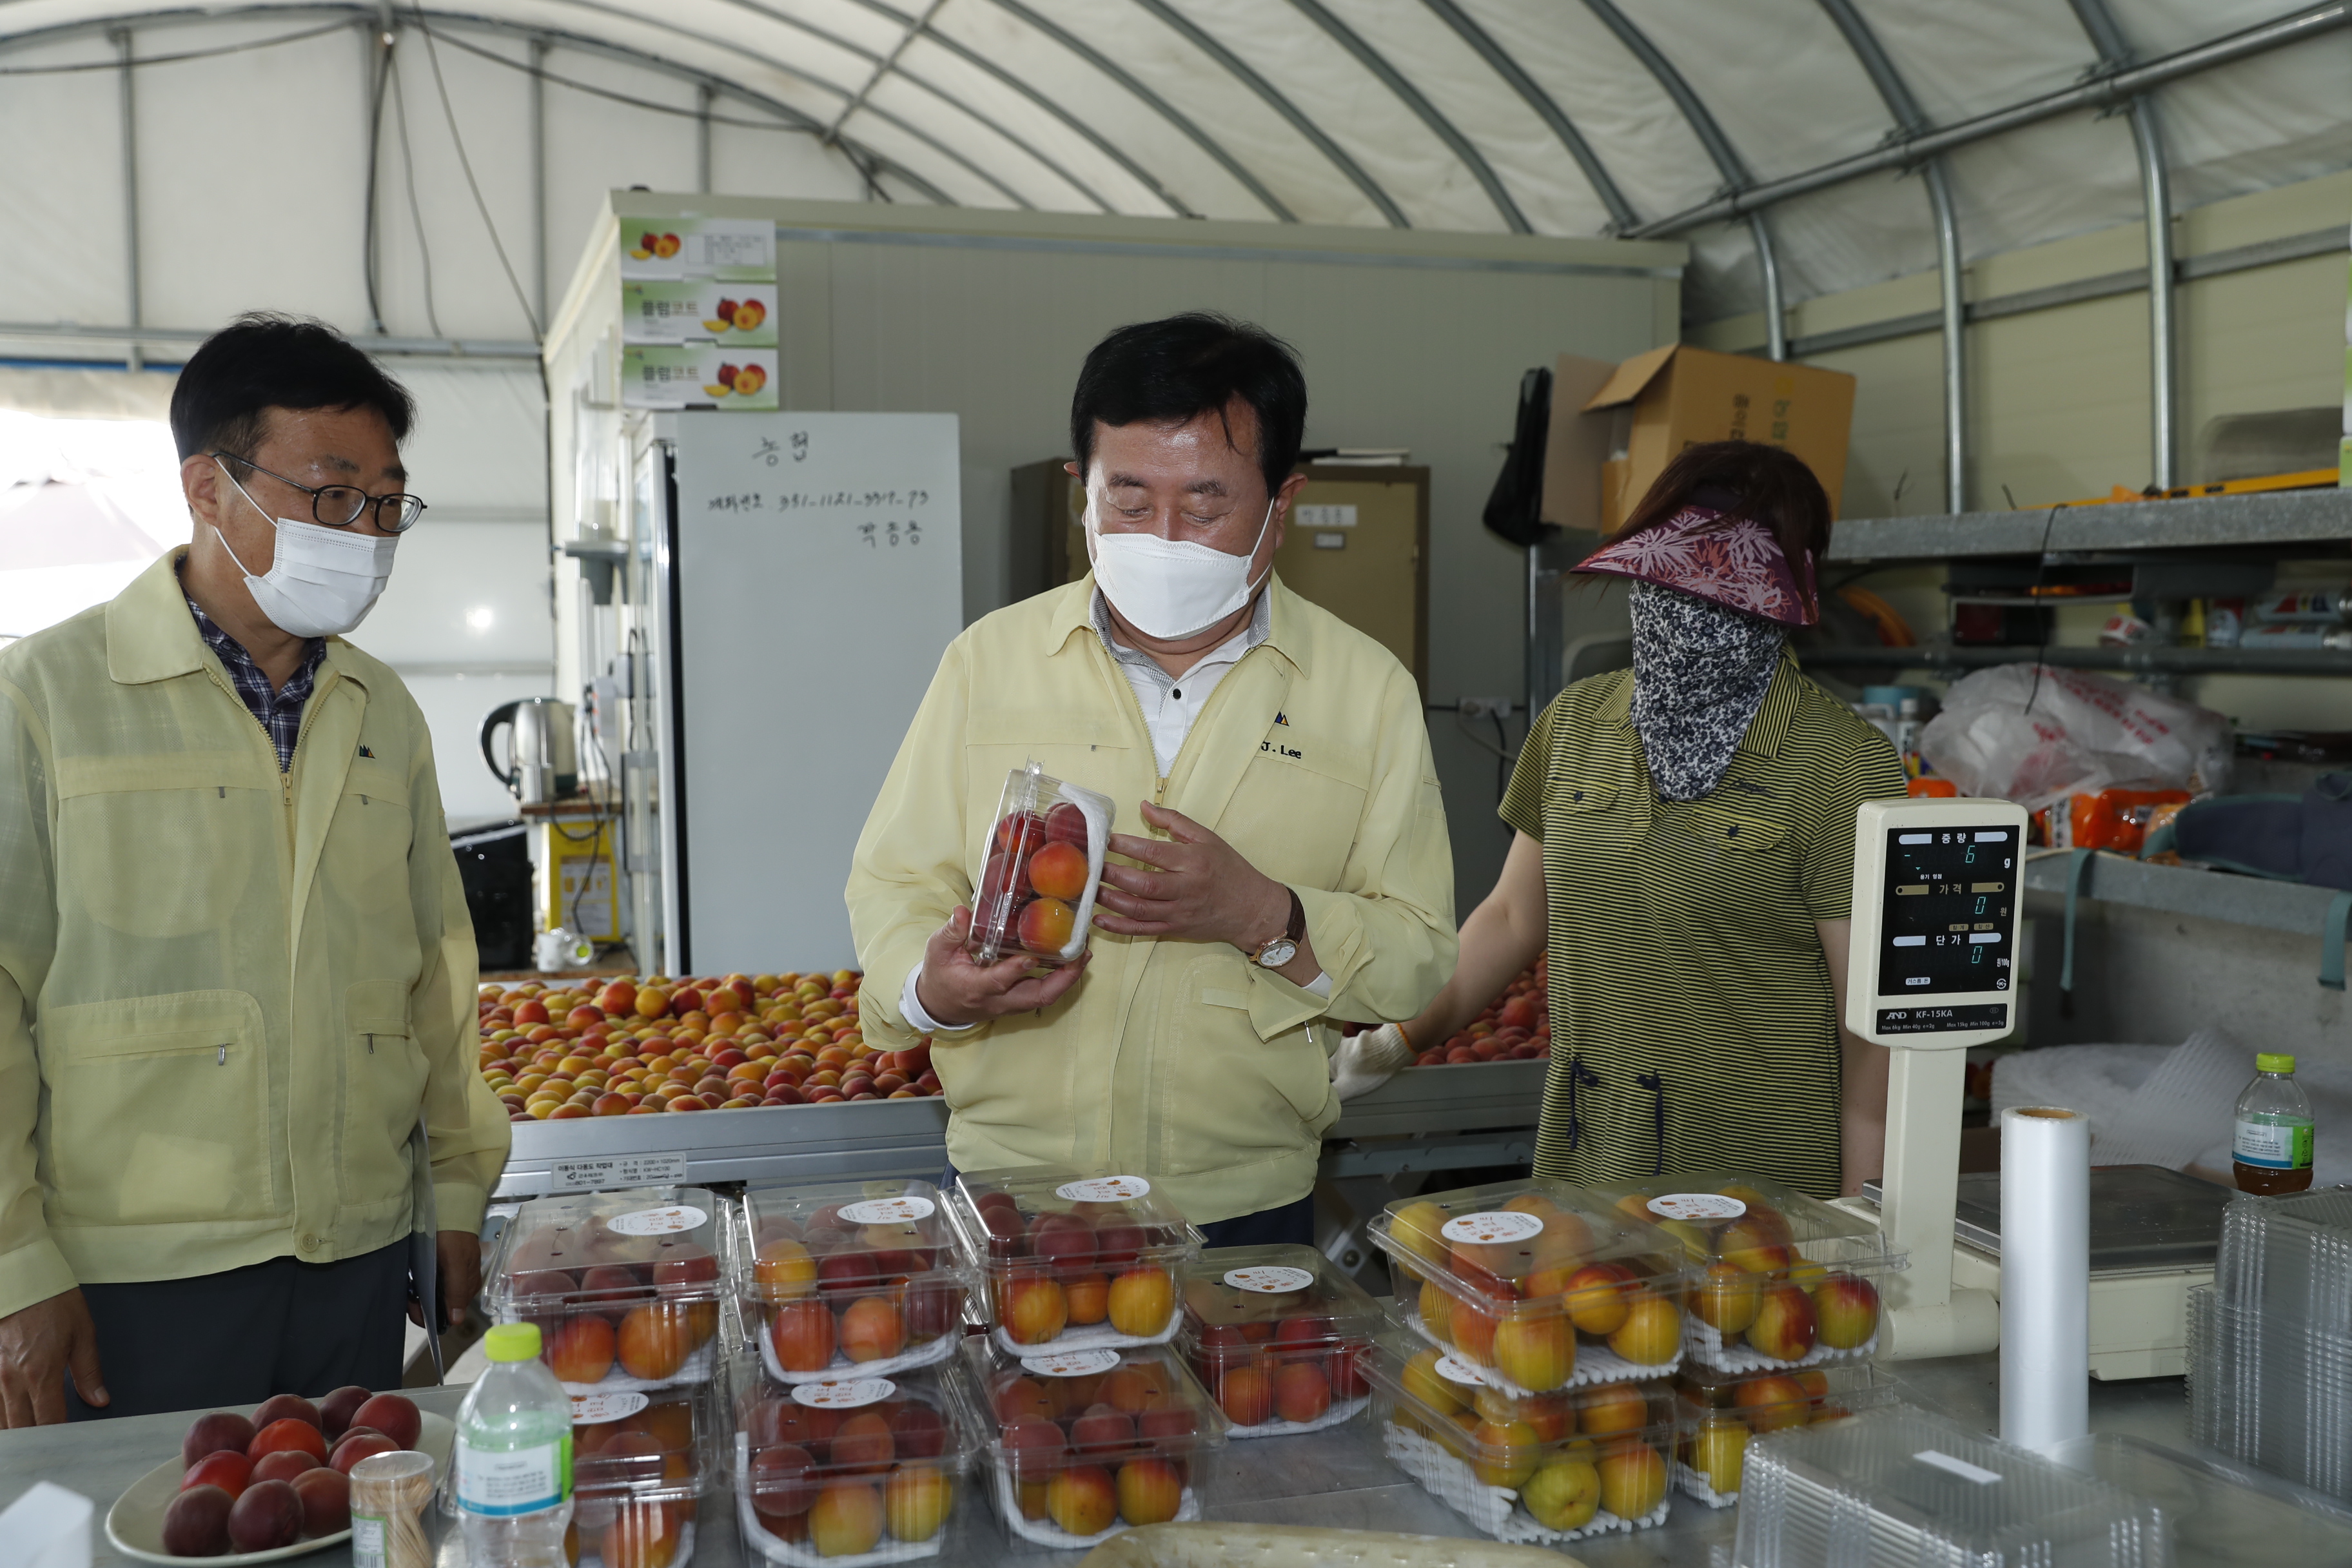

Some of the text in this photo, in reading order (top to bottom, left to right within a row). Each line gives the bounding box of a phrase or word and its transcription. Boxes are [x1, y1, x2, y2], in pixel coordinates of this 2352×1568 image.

[1280, 745, 1302, 759] Lee
[2004, 858, 2011, 868] g
[2000, 907, 2007, 916] 원
[1916, 1010, 1953, 1019] KF-15KA
